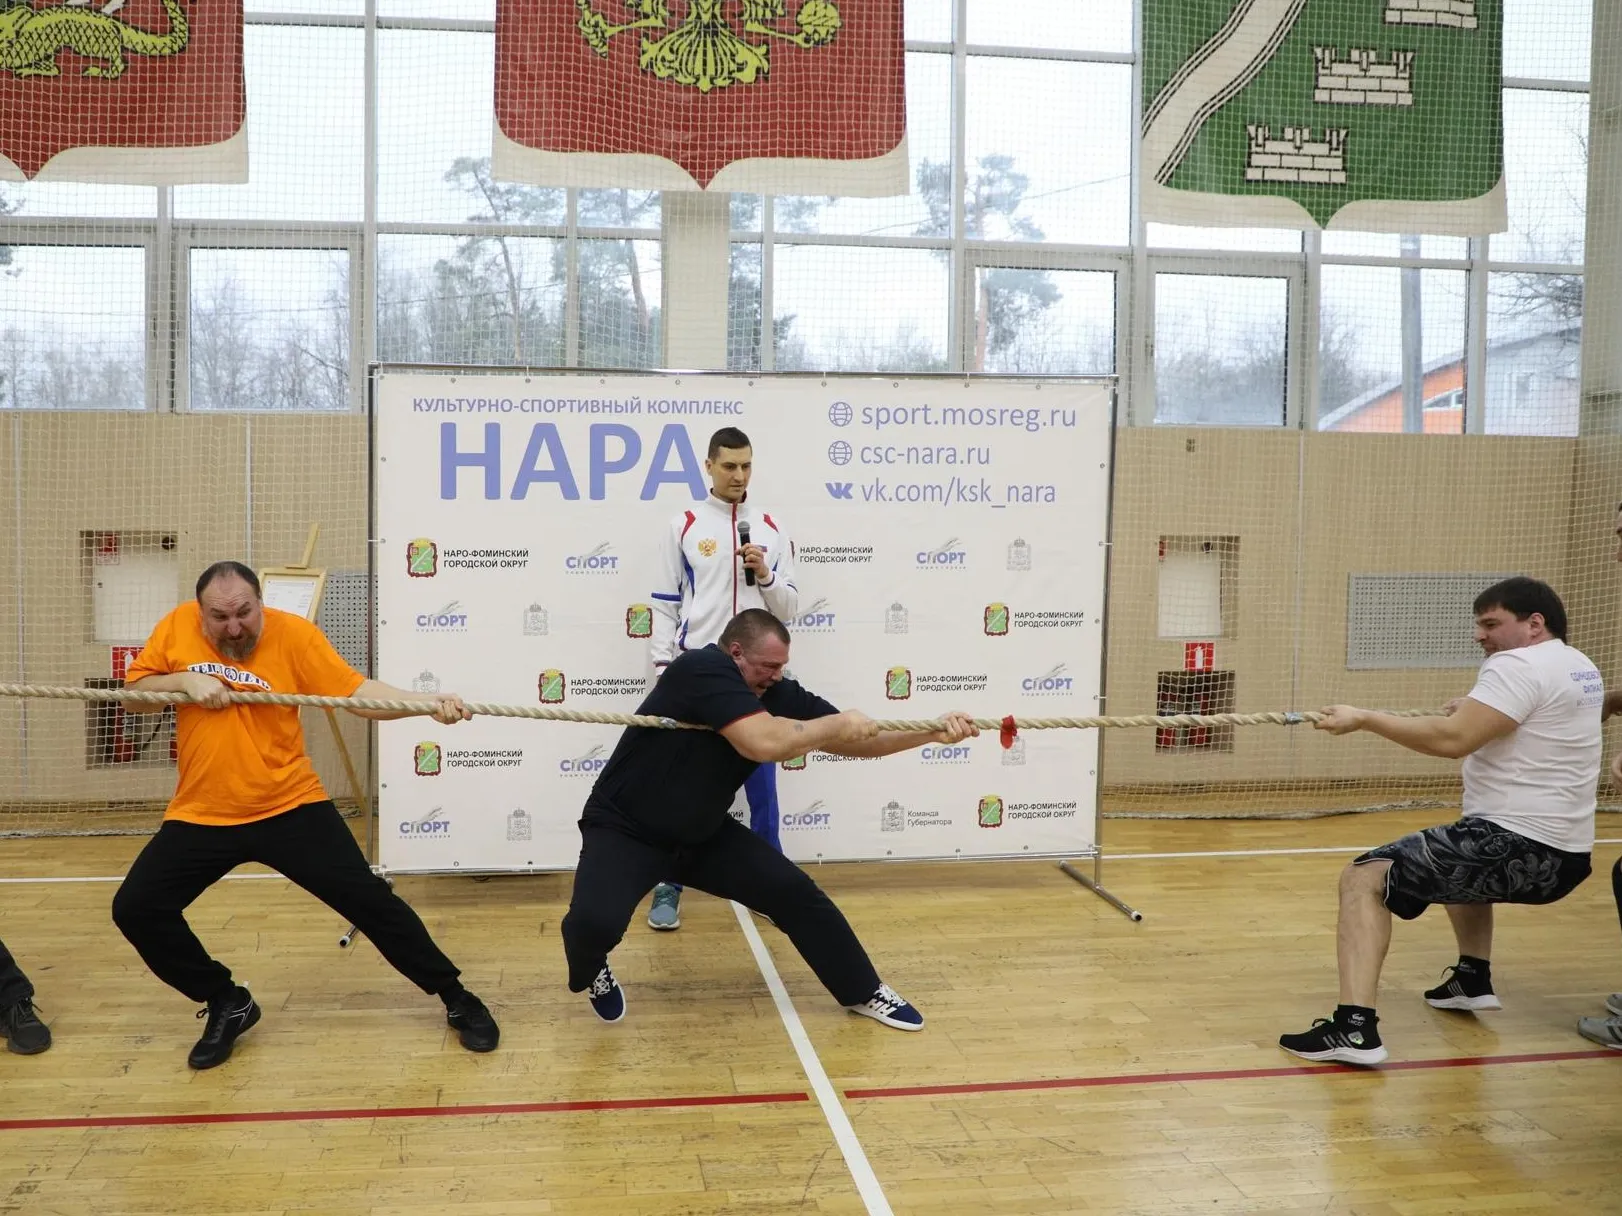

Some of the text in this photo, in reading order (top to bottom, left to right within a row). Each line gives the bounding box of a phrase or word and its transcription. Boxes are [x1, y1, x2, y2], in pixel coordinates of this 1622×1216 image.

[413, 396, 744, 415] КУЛЬТУРНО-СПОРТИВНЫЙ КОМПЛЕКС
[861, 403, 1076, 432] sport.mosreg.ru
[860, 446, 990, 465] csc-nara.ru
[440, 422, 708, 500] НАРА
[861, 476, 1056, 508] vk.com/ksk_nara
[443, 548, 529, 558] НАРО-ФОМИНСКИЙ
[800, 545, 873, 554] НАРО-ФОМИНСКИЙ
[443, 558, 529, 569] ГОРОДСКОЙ ОКРУГ
[799, 554, 873, 564] ГОРОДСКОЙ ОКРУГ
[1014, 610, 1084, 619] НАРО-ФОМИНСКИЙ
[1014, 619, 1084, 629] ГОРОДСКОЙ ОКРУГ
[570, 677, 647, 687] НАРО-ФОМИНСКИЙ
[916, 673, 988, 683] НАРО-ФОМИНСКИЙ
[570, 685, 647, 697] ГОРОДСКОЙ ОКРУГ
[916, 682, 988, 693] ГОРОДСКОЙ ОКРУГ
[446, 749, 523, 759] НАРО-ФОМИНСКИЙ
[446, 758, 523, 768] ГОРОДСКОЙ ОКРУГ
[1008, 801, 1077, 811] НАРО-ФОМИНСКИЙ
[907, 810, 939, 818] Команда
[1008, 810, 1076, 820] ГОРОДСКОЙ ОКРУГ
[907, 819, 953, 828] Губернатора
